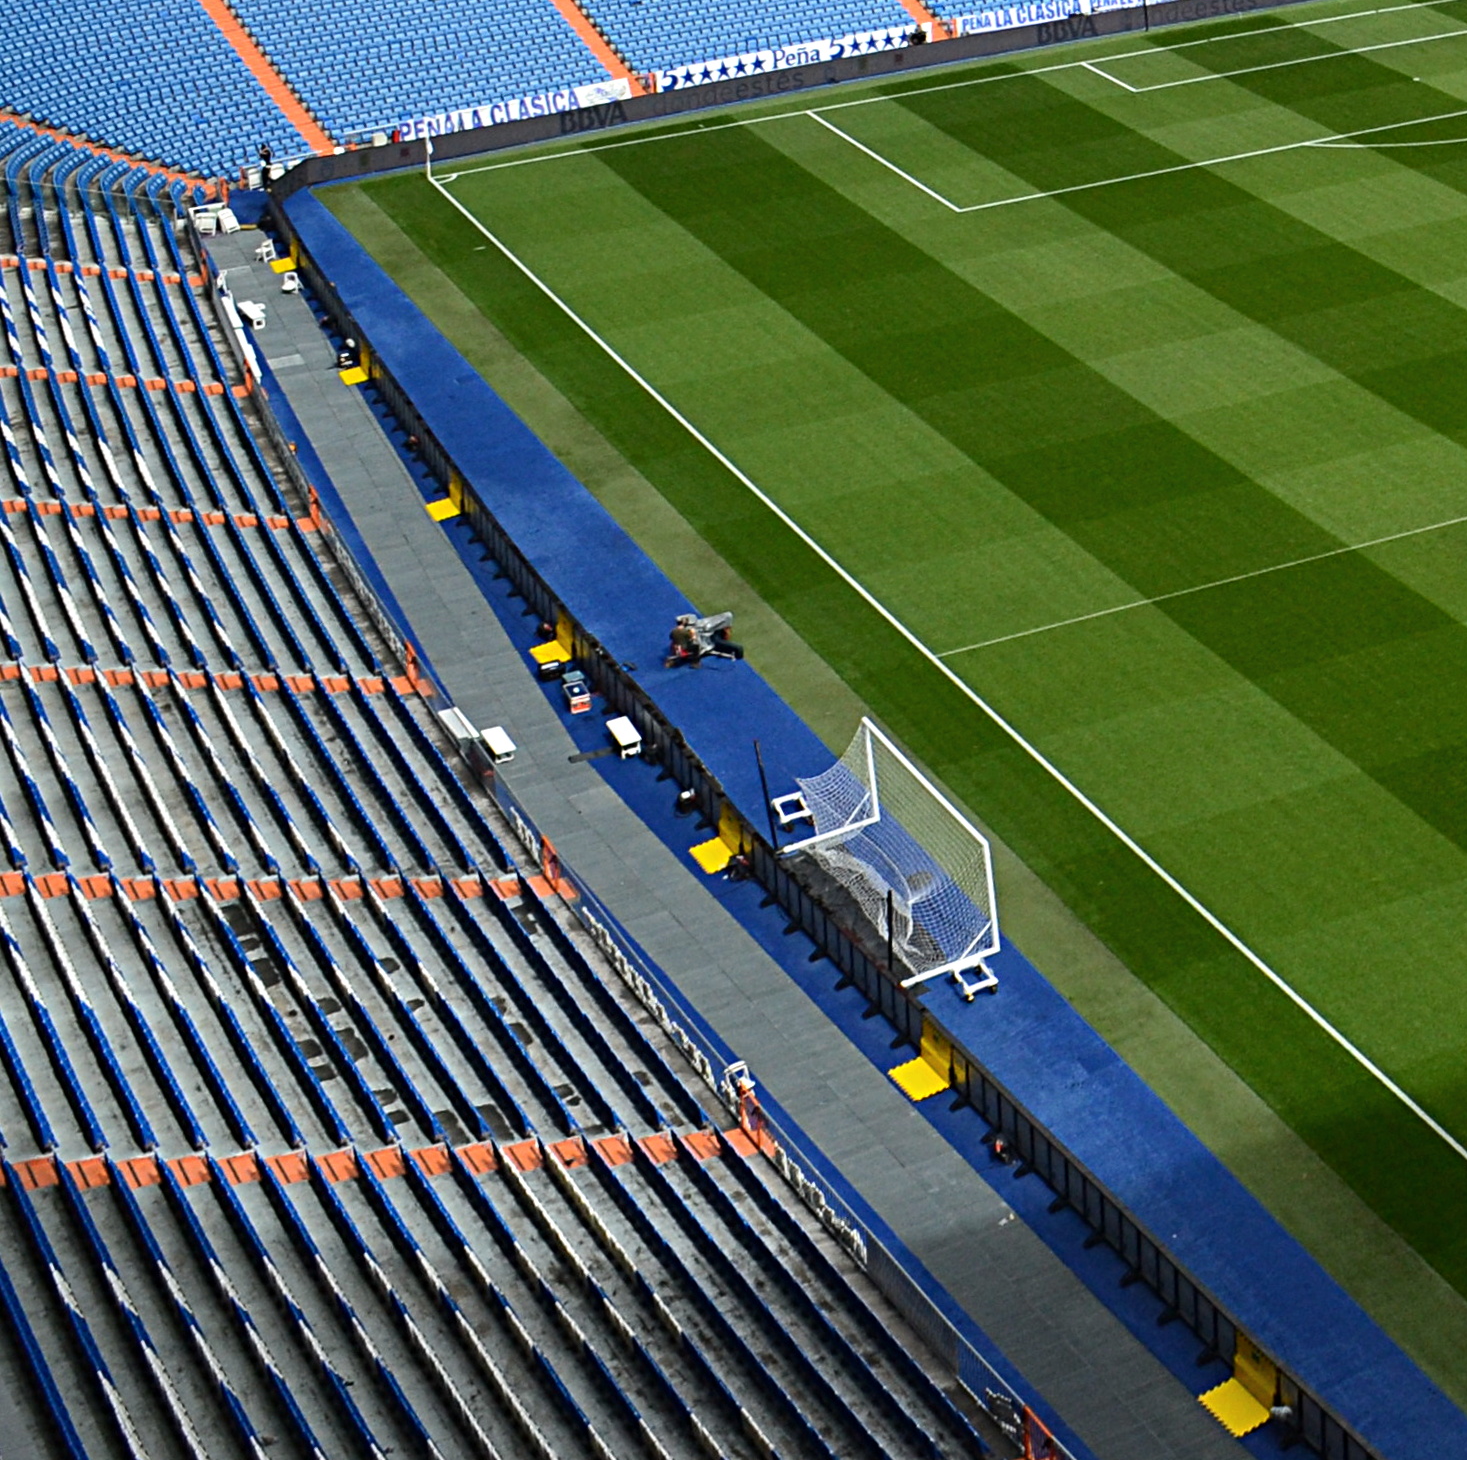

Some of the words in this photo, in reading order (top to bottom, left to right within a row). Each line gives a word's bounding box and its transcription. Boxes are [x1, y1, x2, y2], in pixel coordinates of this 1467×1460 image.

[995, 10, 1013, 27] LA
[1037, 16, 1098, 44] BBVA
[772, 47, 820, 69] Peña
[560, 102, 627, 133] BBVA
